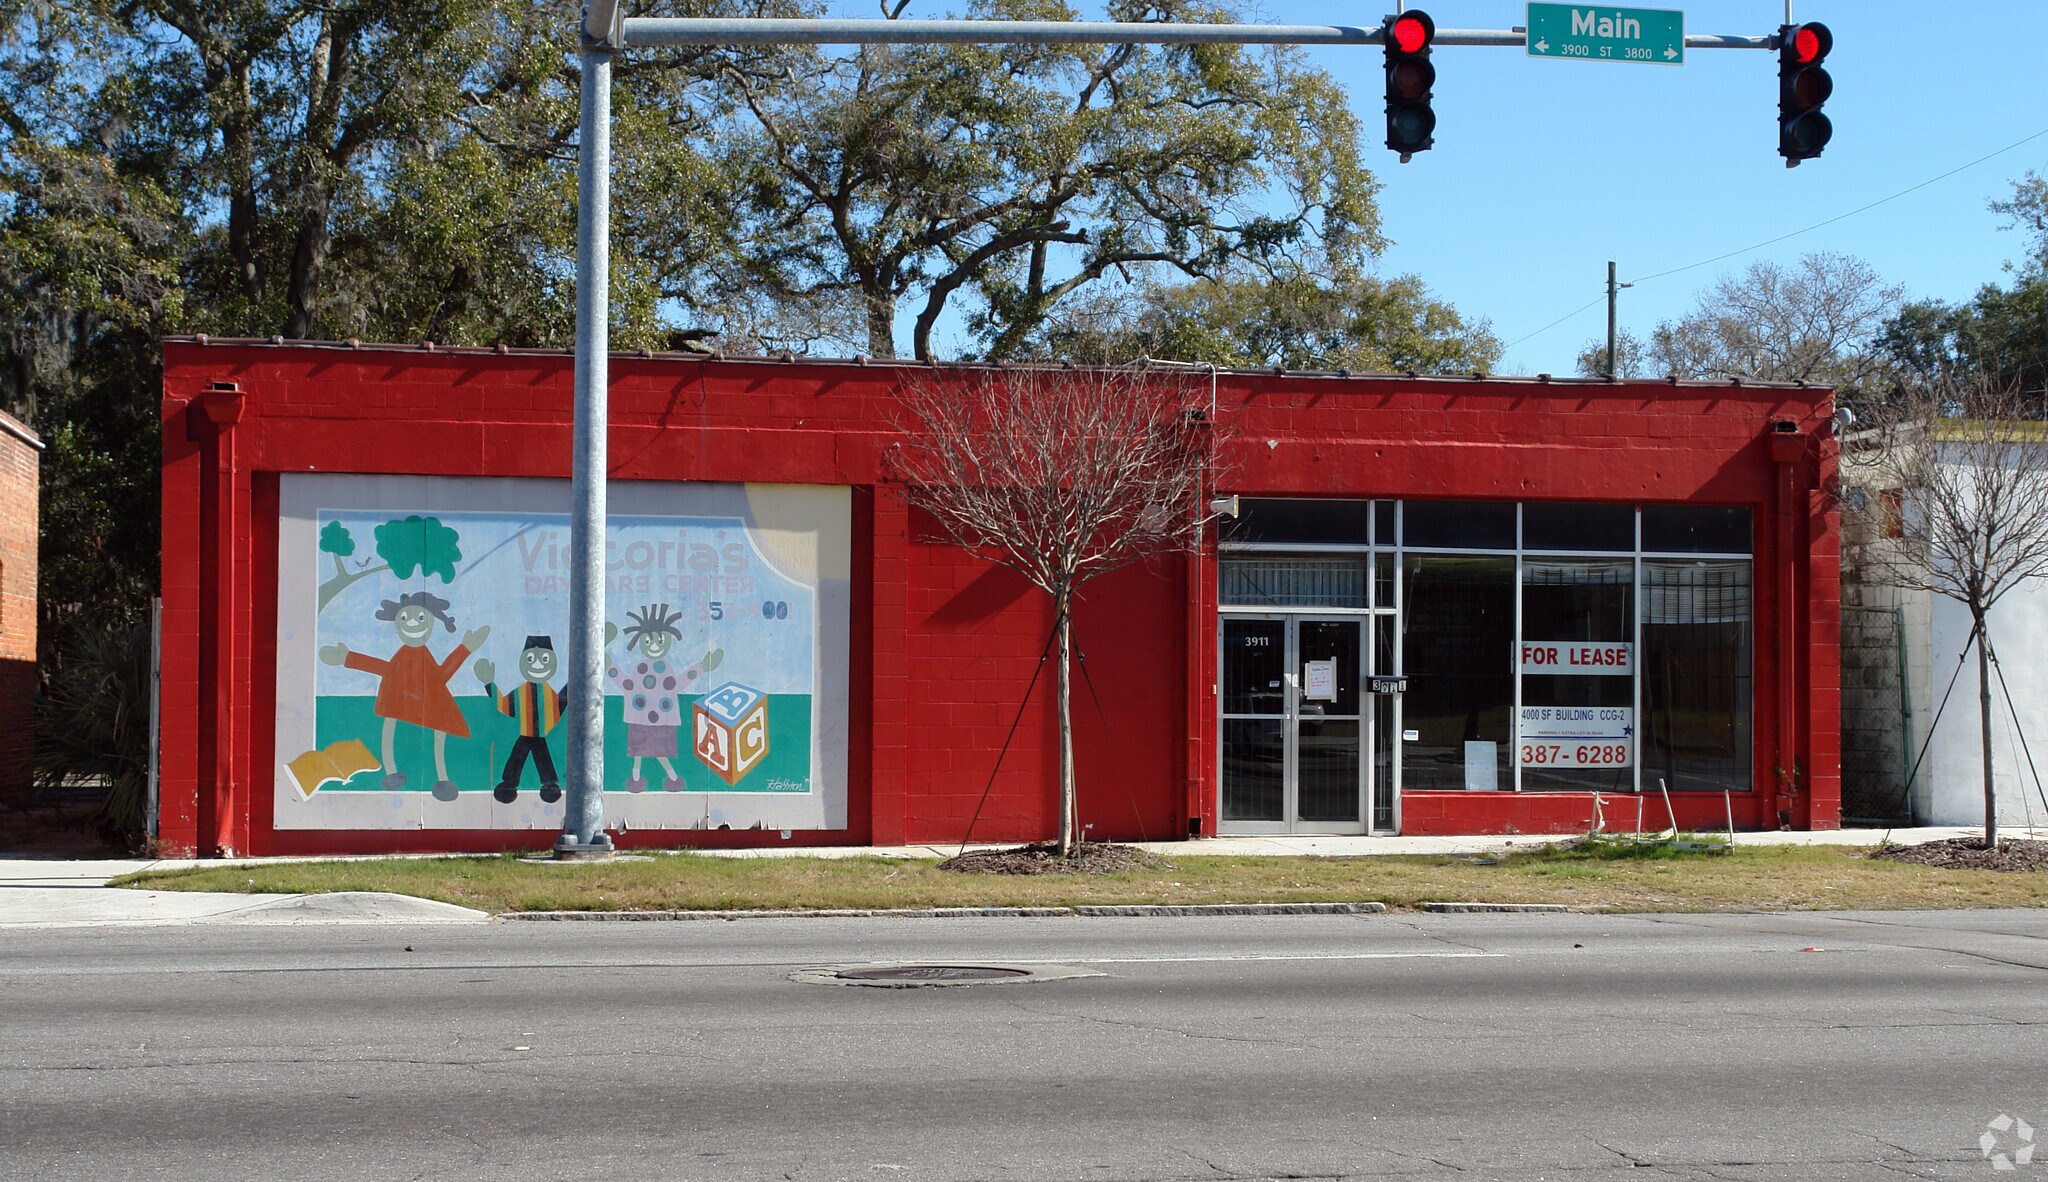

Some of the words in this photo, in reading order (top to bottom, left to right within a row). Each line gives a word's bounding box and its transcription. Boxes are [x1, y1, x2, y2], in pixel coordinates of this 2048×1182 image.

[1571, 9, 1640, 39] Main
[1561, 44, 1589, 56] 3900
[1600, 46, 1613, 57] ST
[1624, 47, 1653, 59] 3800
[516, 529, 749, 574] Vioria's
[1244, 636, 1269, 647] 3911
[1521, 647, 1558, 665] FOR
[1569, 648, 1627, 666] LEASE
[1521, 709, 1540, 720] 4000
[1541, 709, 1552, 720] SF
[1556, 709, 1594, 721] BUILDING
[1600, 709, 1625, 721] CCG-2
